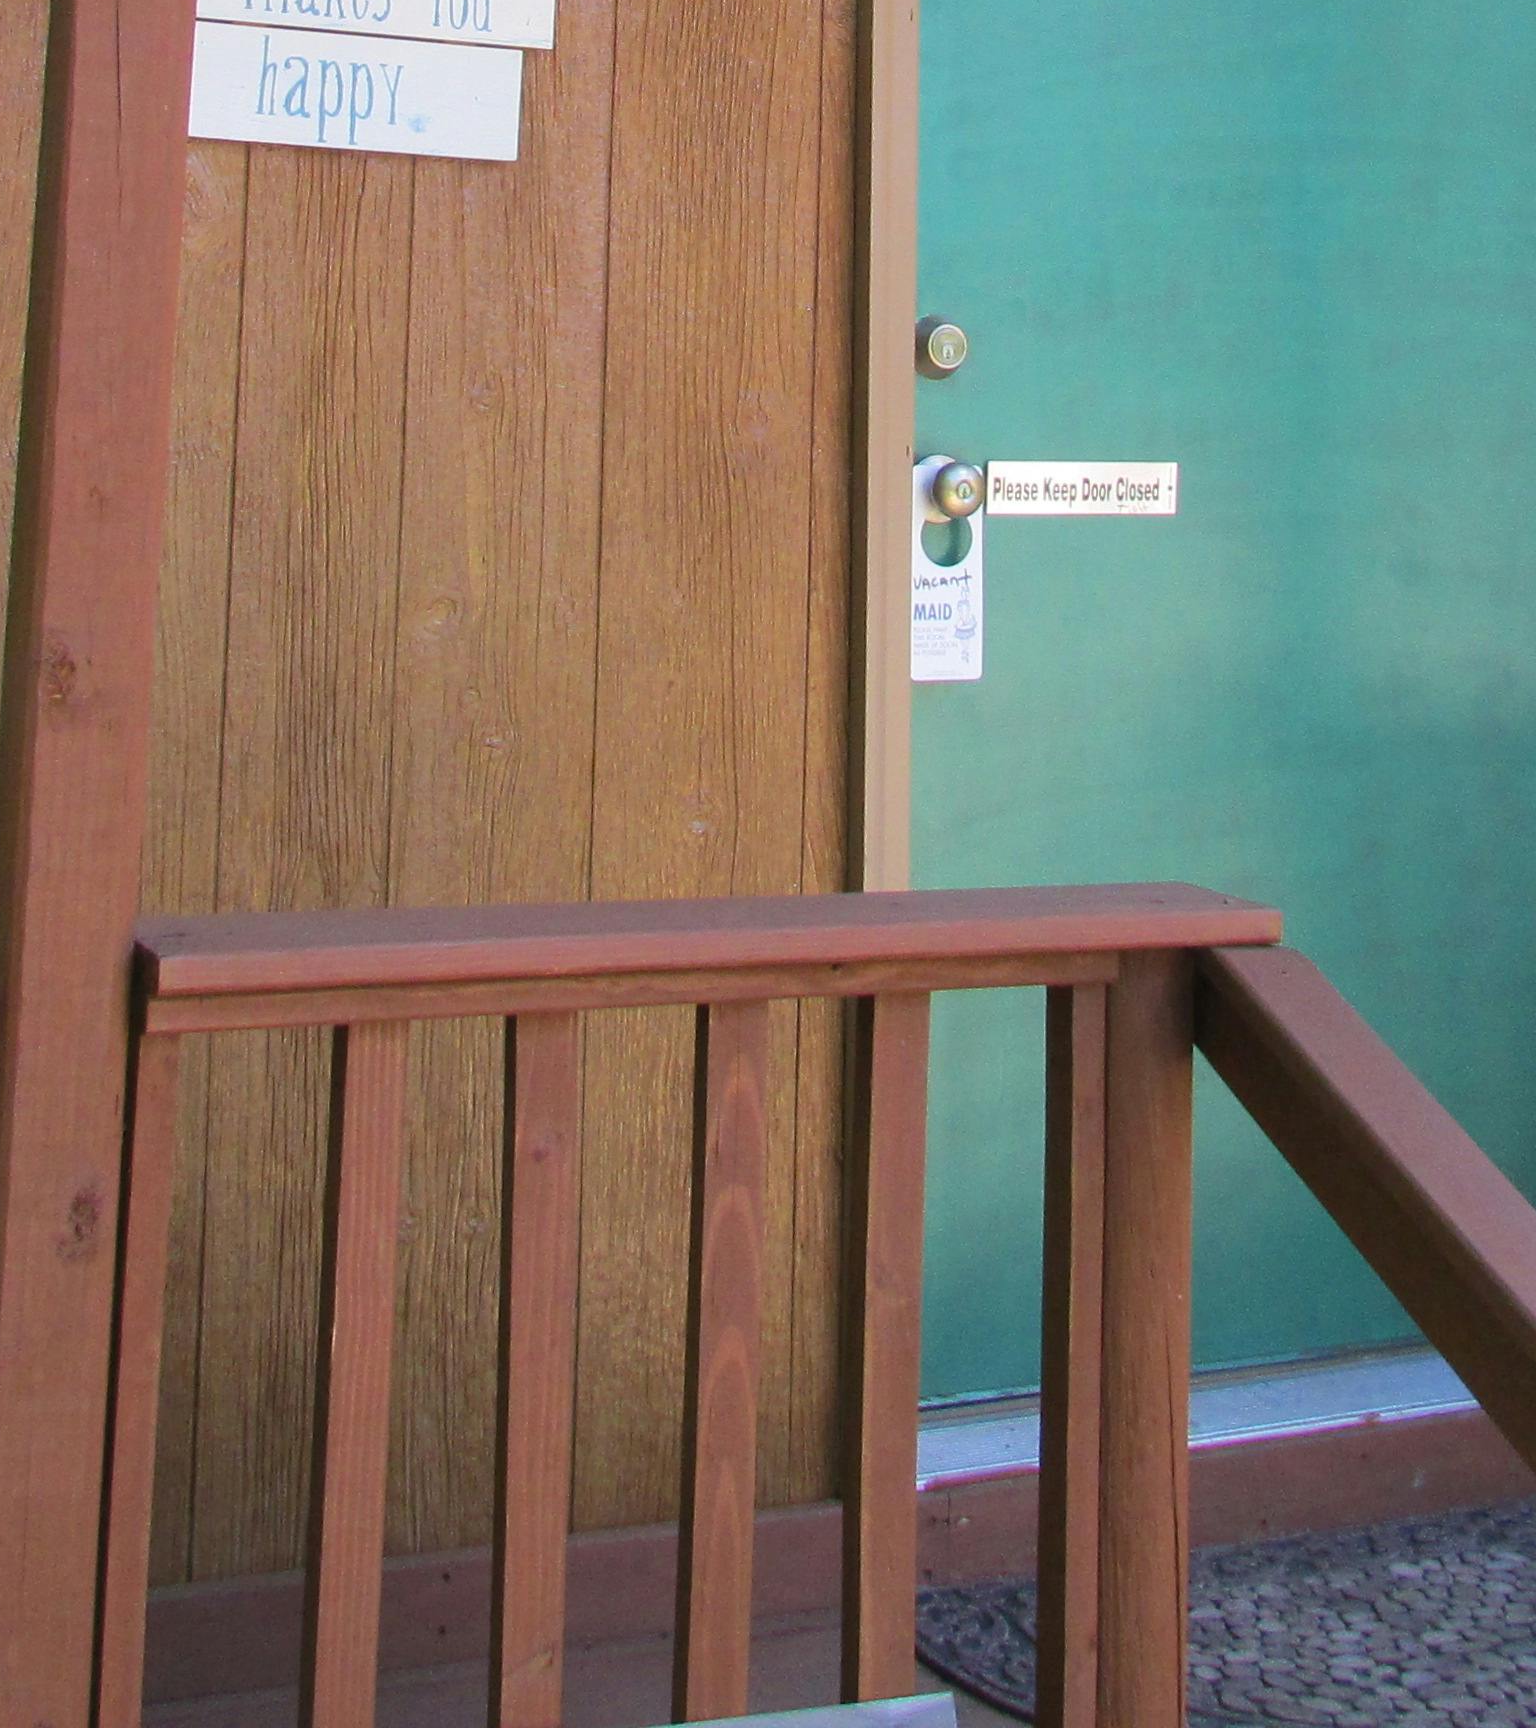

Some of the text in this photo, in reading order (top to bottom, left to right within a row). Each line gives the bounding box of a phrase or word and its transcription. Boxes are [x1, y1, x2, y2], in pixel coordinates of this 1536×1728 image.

[255, 34, 404, 145] happy
[993, 476, 1160, 508] Please Keep Door Closed
[913, 602, 953, 621] MAID
